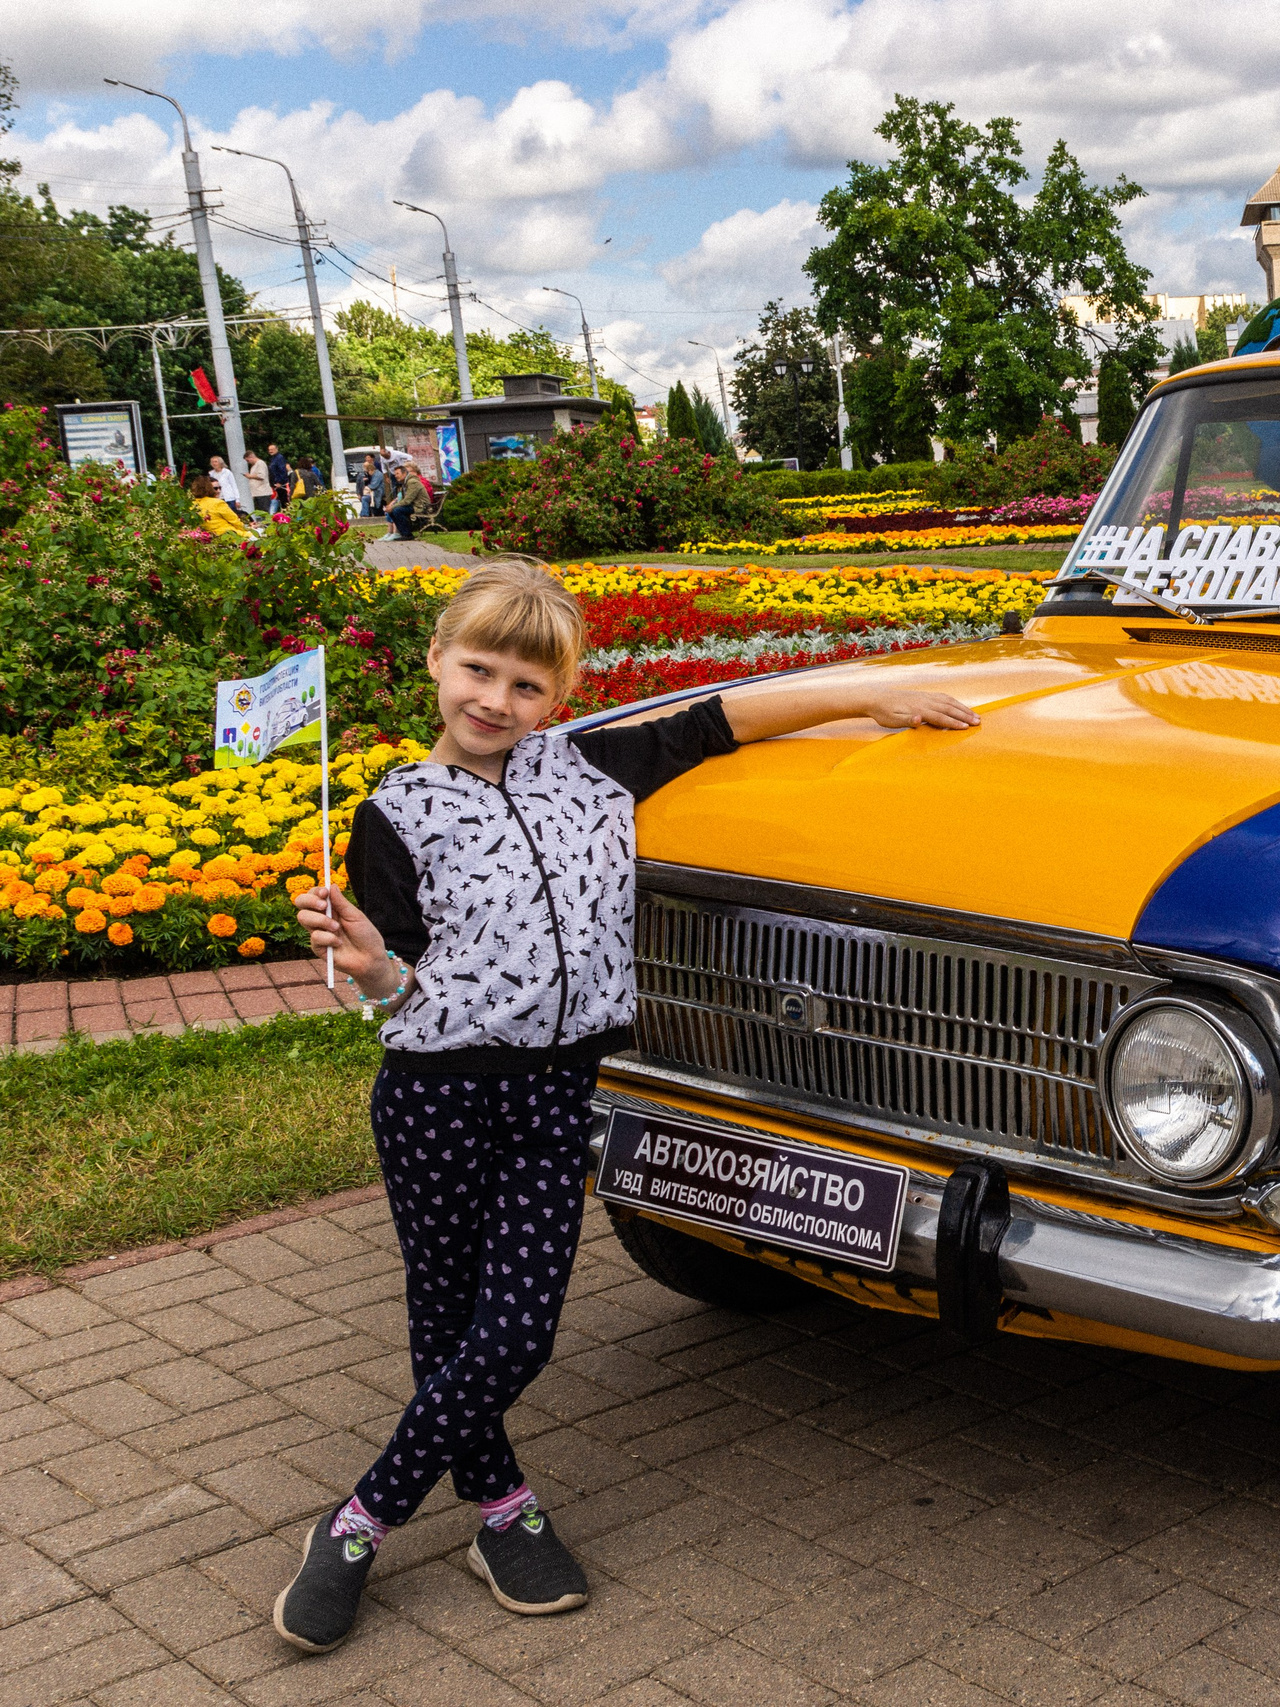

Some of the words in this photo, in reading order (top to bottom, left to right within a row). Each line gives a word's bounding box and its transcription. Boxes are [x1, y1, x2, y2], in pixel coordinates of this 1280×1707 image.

[1080, 525, 1164, 562] #НА
[613, 1168, 643, 1196] УВД
[650, 1178, 747, 1218] ВИТЕБСКОГО
[750, 1202, 882, 1252] ОБЛИСПОЛКОМА
[633, 1131, 865, 1212] АВТОХОЗЯЙСТВО
